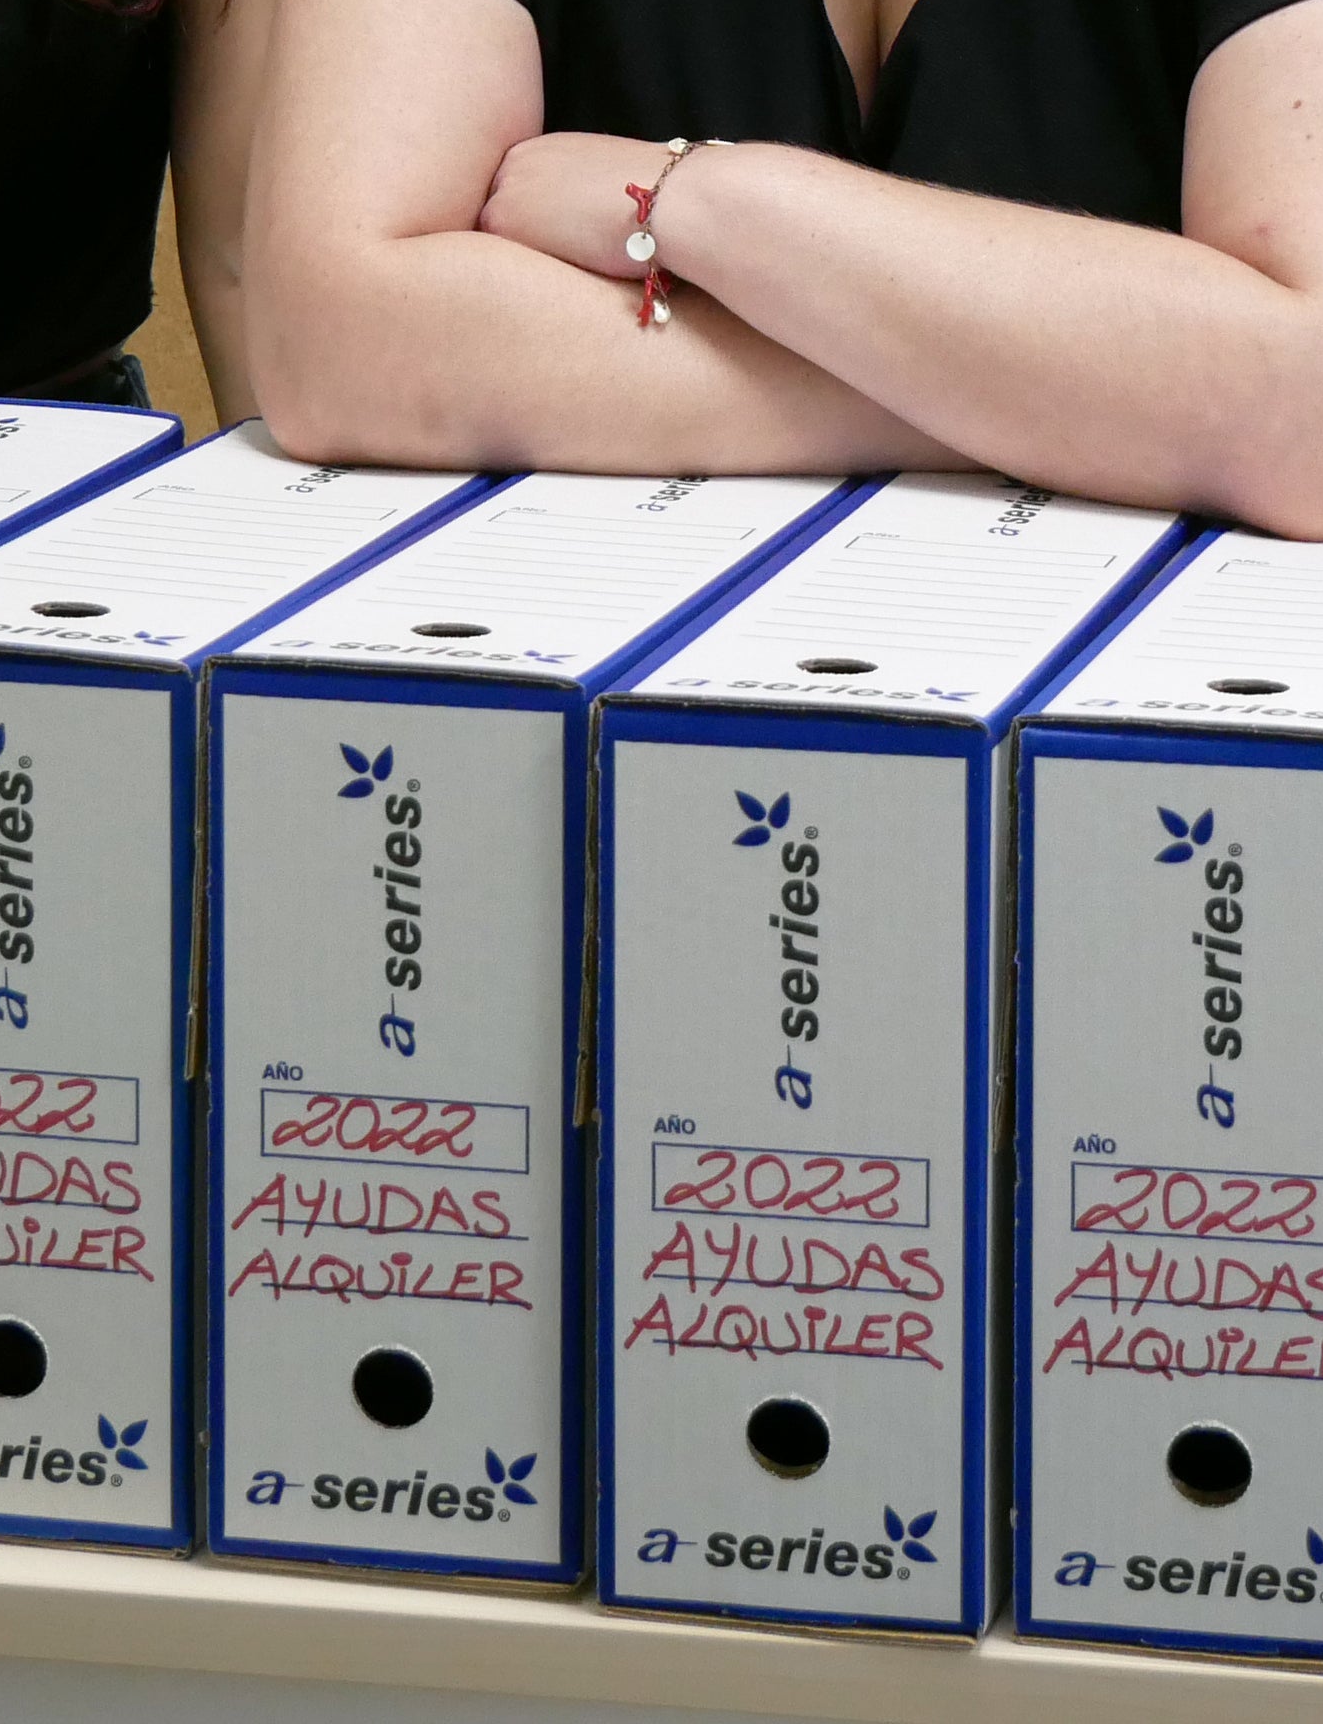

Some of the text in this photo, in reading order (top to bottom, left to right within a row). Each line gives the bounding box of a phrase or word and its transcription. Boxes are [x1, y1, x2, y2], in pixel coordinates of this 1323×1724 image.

[262, 1061, 304, 1081] AÑO
[272, 1094, 476, 1157] 2022
[653, 1114, 696, 1135] AÑO
[1073, 1135, 1116, 1154] AÑO
[231, 1172, 510, 1238] AYUDAS
[664, 1151, 900, 1219] 2022
[1076, 1168, 1317, 1238] 2022
[642, 1220, 944, 1301] AYUDAS
